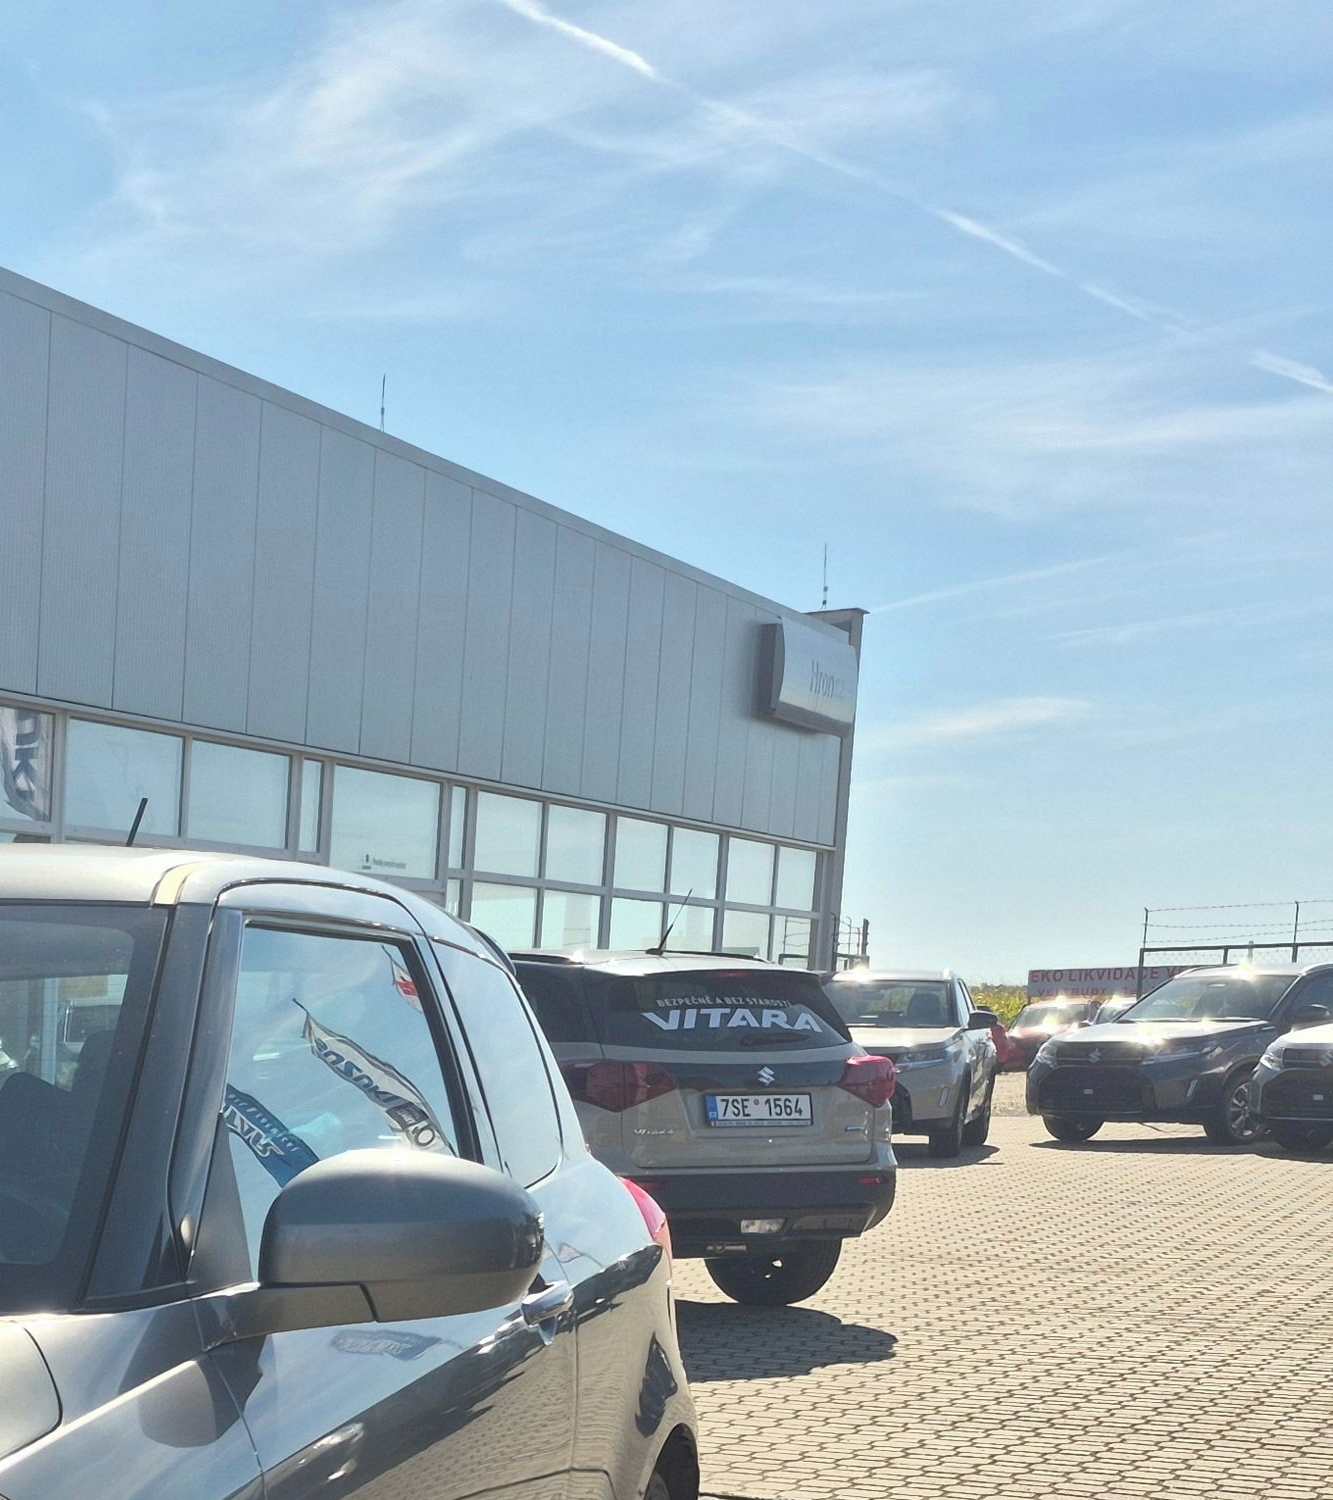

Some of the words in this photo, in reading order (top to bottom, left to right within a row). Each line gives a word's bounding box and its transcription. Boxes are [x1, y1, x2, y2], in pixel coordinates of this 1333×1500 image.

[1029, 971, 1063, 983] EKO
[641, 1008, 823, 1033] VITARA
[720, 1098, 751, 1117] 7SE
[765, 1097, 803, 1117] 1564
